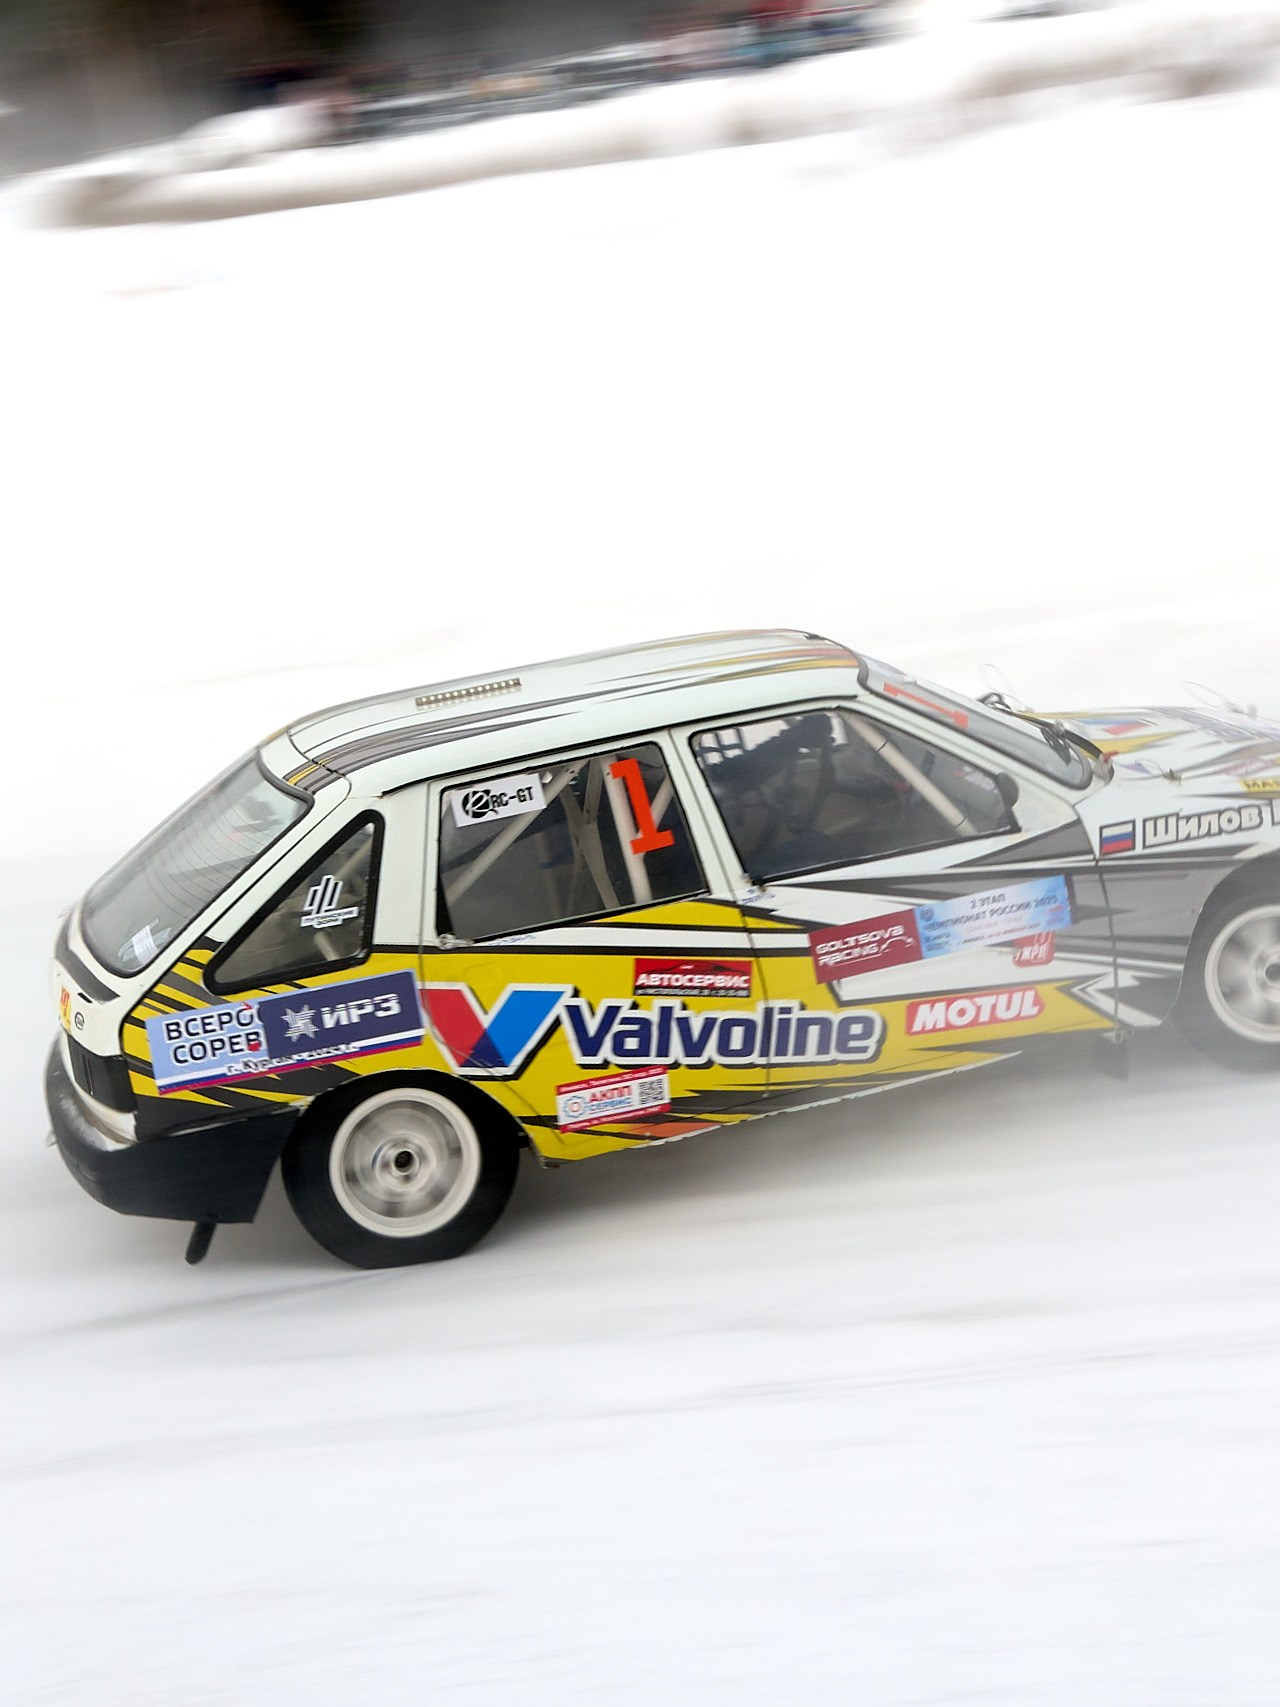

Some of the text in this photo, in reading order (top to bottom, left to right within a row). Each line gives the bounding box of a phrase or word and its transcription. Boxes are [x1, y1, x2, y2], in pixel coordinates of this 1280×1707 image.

[489, 786, 534, 809] RC-GT
[609, 757, 675, 855] 1
[1142, 804, 1263, 849] Шилов
[635, 973, 750, 988] АВТОСЕРВИС
[320, 993, 401, 1029] ИРЗ
[911, 989, 1040, 1032] MOTUL
[562, 1000, 884, 1064] Valvoline
[589, 1085, 632, 1103] АКПП
